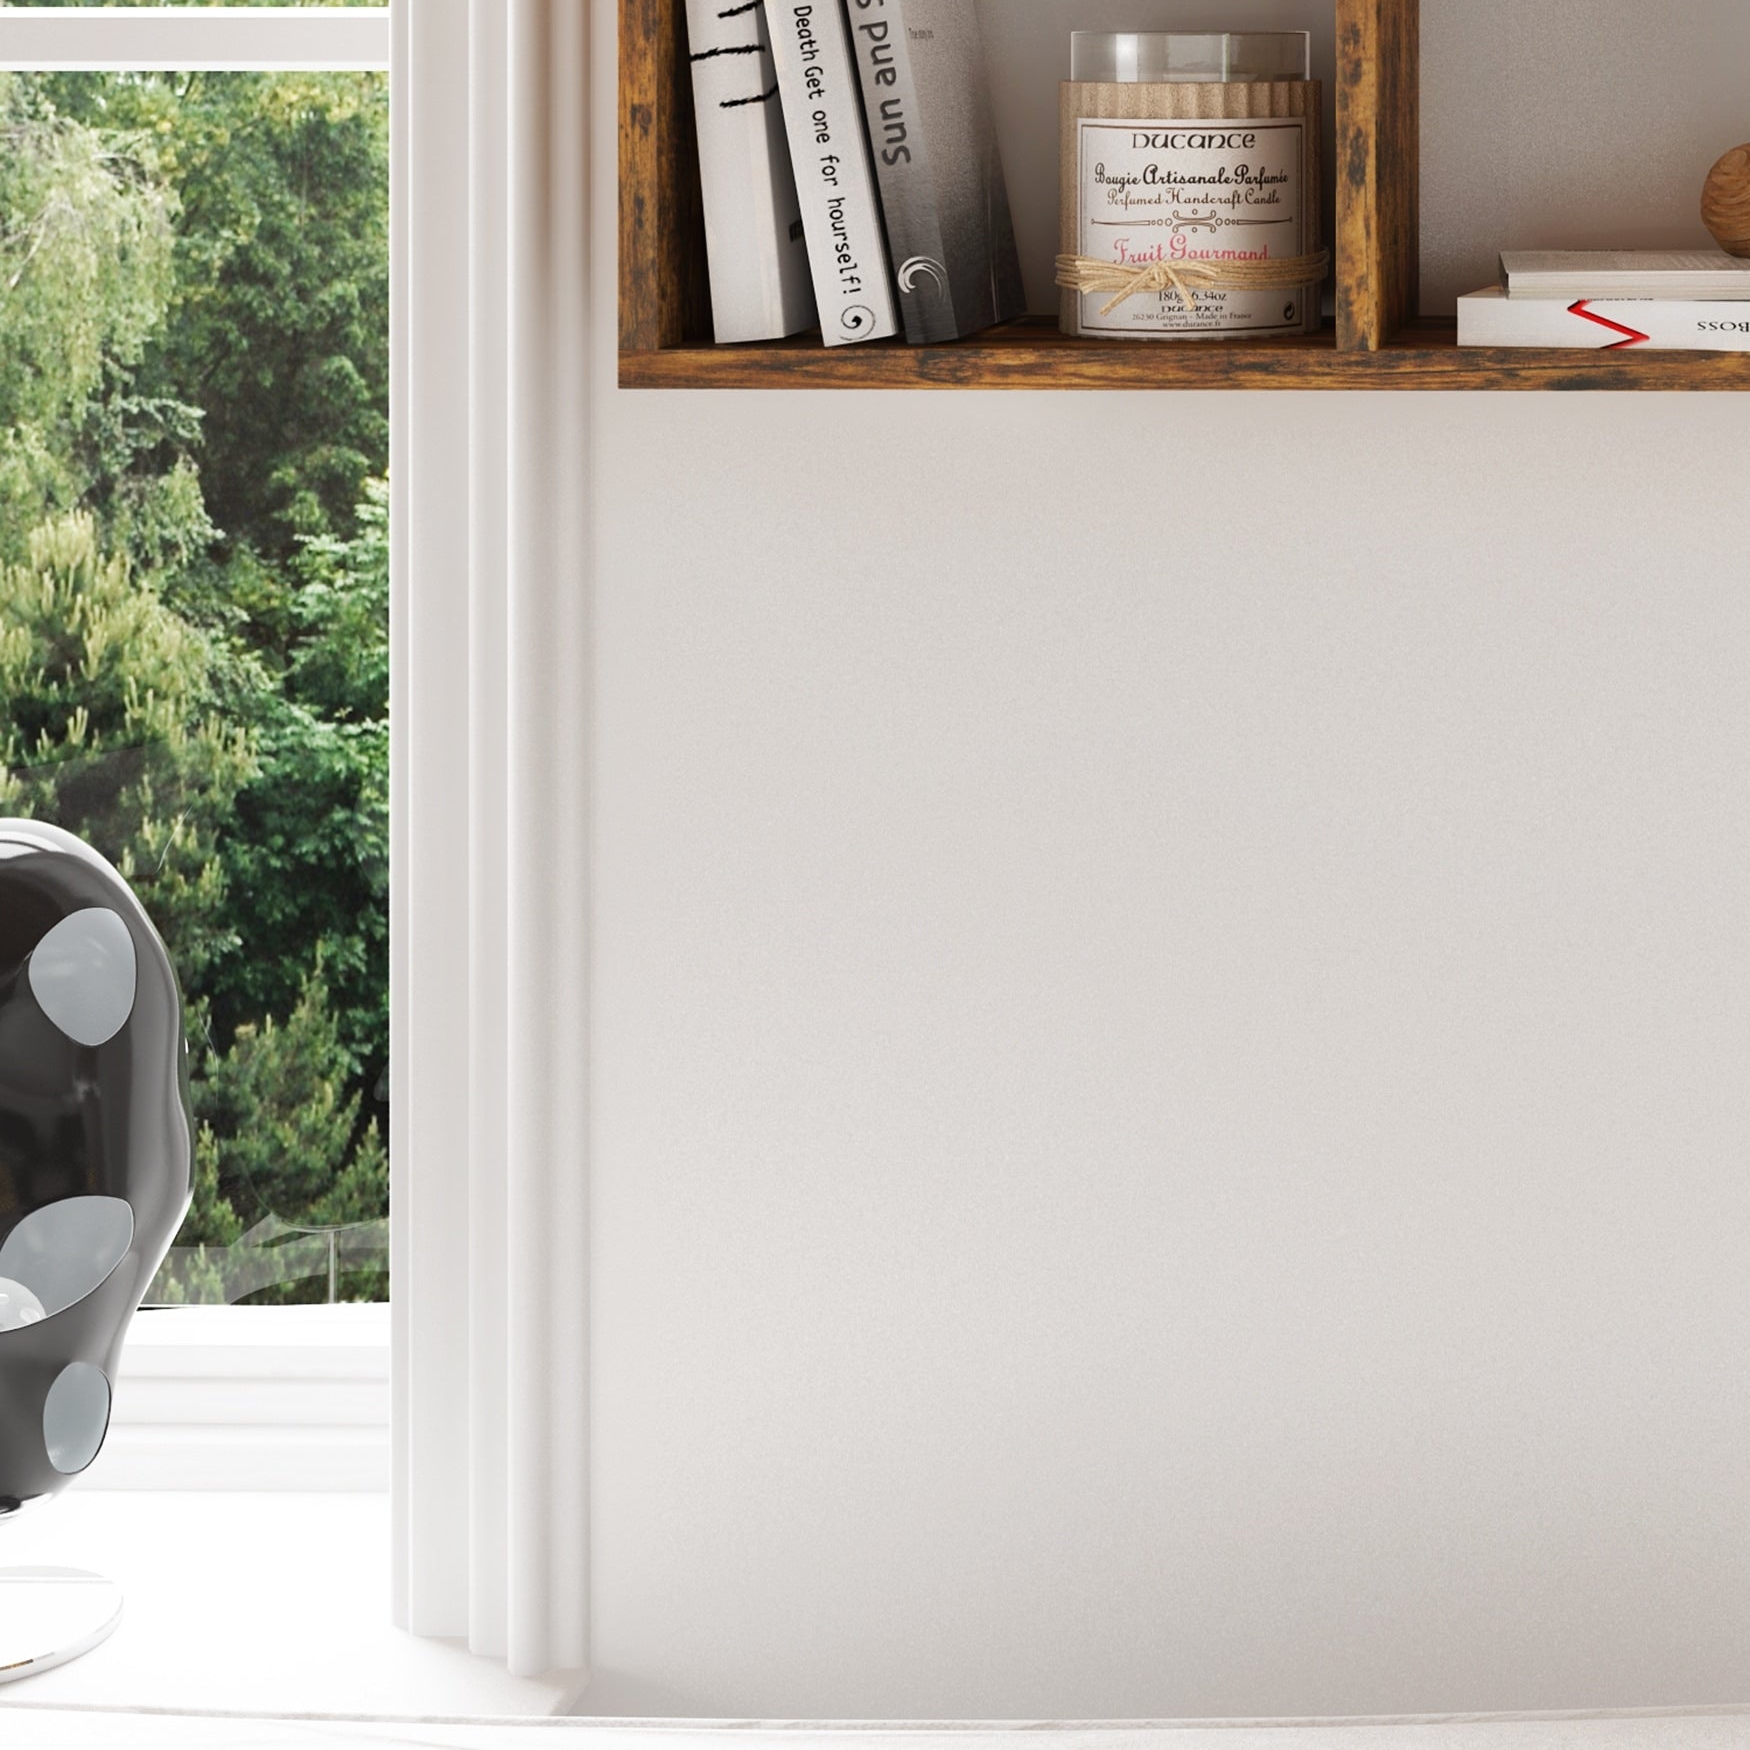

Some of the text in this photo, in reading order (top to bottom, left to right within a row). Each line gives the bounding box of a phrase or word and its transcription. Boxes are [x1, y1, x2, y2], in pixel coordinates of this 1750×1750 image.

[858, 20, 898, 88] and
[812, 110, 830, 144] one
[881, 99, 912, 166] Sun
[820, 155, 840, 186] for
[1095, 162, 1141, 193] Bougie
[1143, 164, 1233, 185] Artisanale
[1107, 187, 1281, 210] Perfumed Handcraft Candle
[827, 197, 862, 294] hourself!
[1113, 234, 1269, 264] Fruit Gourmand
[1196, 312, 1218, 320] Made
[1697, 321, 1750, 332] BOSS
